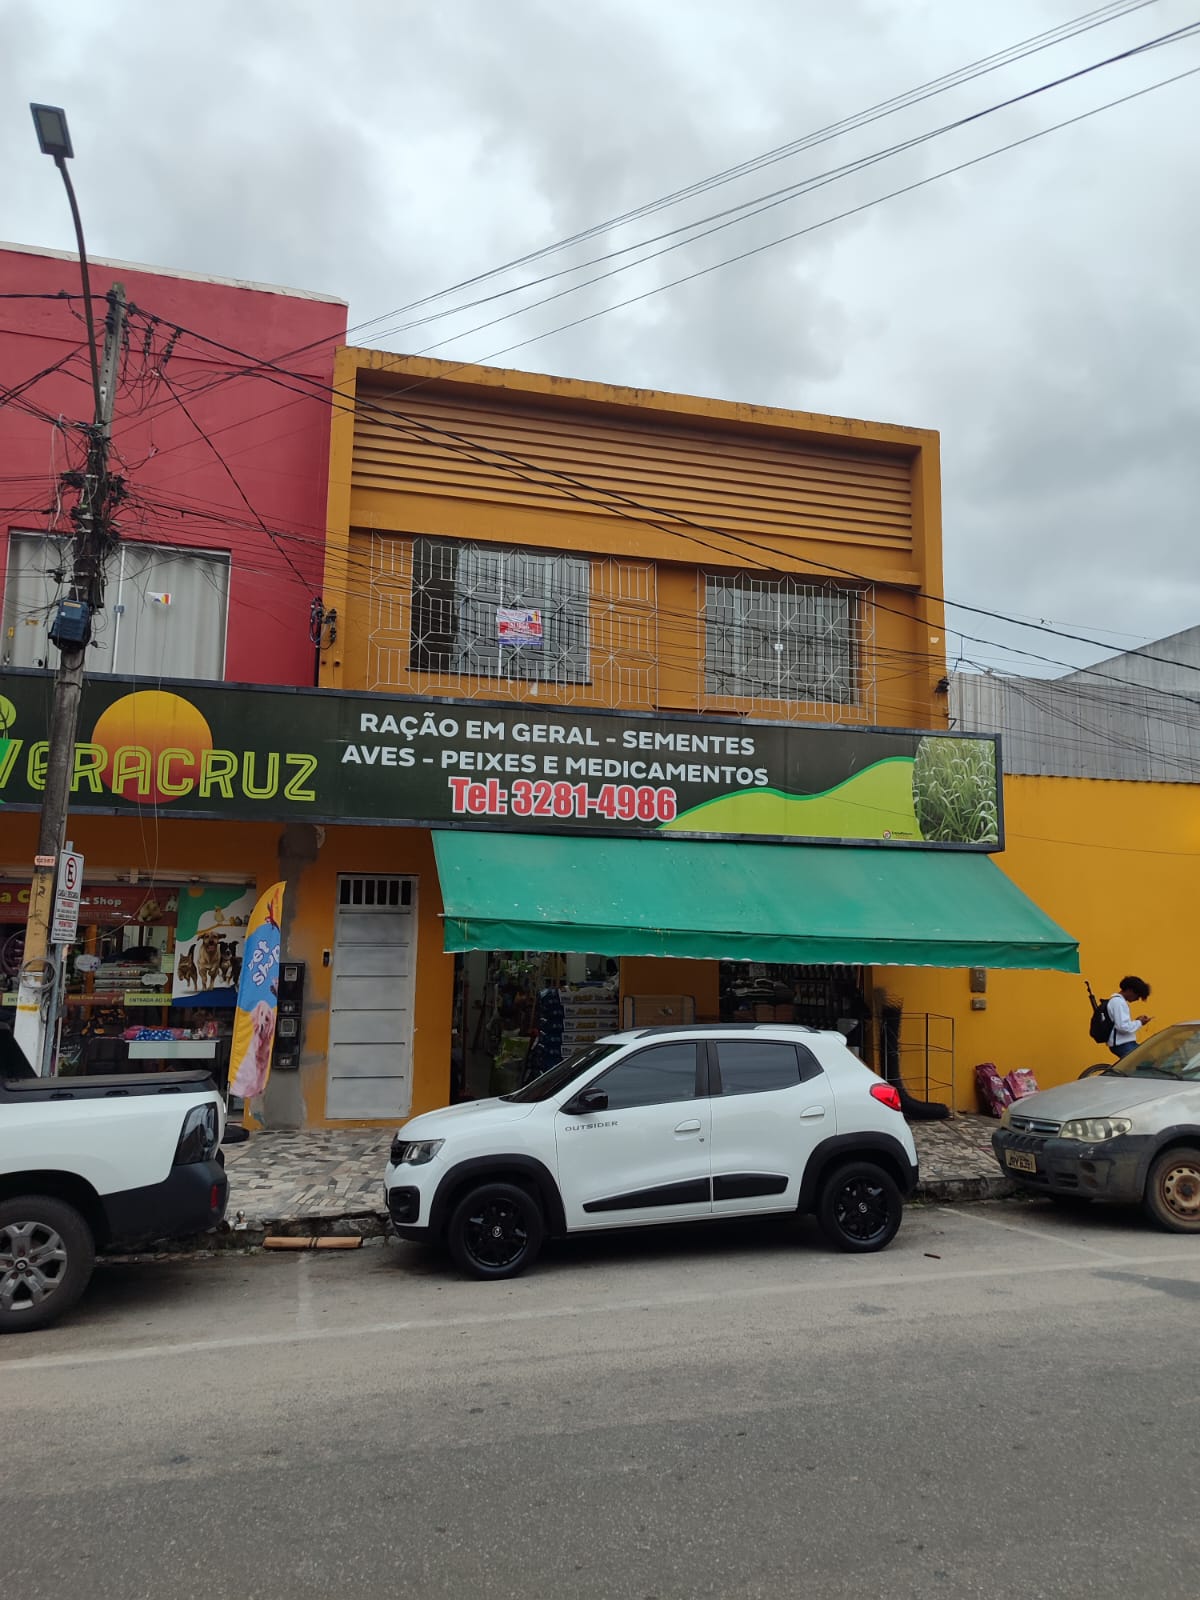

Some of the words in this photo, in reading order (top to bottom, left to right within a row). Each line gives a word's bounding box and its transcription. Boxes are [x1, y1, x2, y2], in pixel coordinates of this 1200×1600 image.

[360, 712, 459, 740] RAÇÃO
[466, 720, 505, 740] EM
[511, 723, 599, 746] GERAL
[622, 730, 755, 755] SEMENTES
[341, 744, 416, 767] AVES
[441, 750, 537, 773] PEIXES
[543, 755, 558, 774] E
[565, 756, 769, 786] MEDICAMENTOS
[448, 776, 508, 815] Tel:
[511, 778, 677, 822] 3281-4986
[93, 896, 122, 907] Shop
[565, 1120, 619, 1132] OUTSIDER
